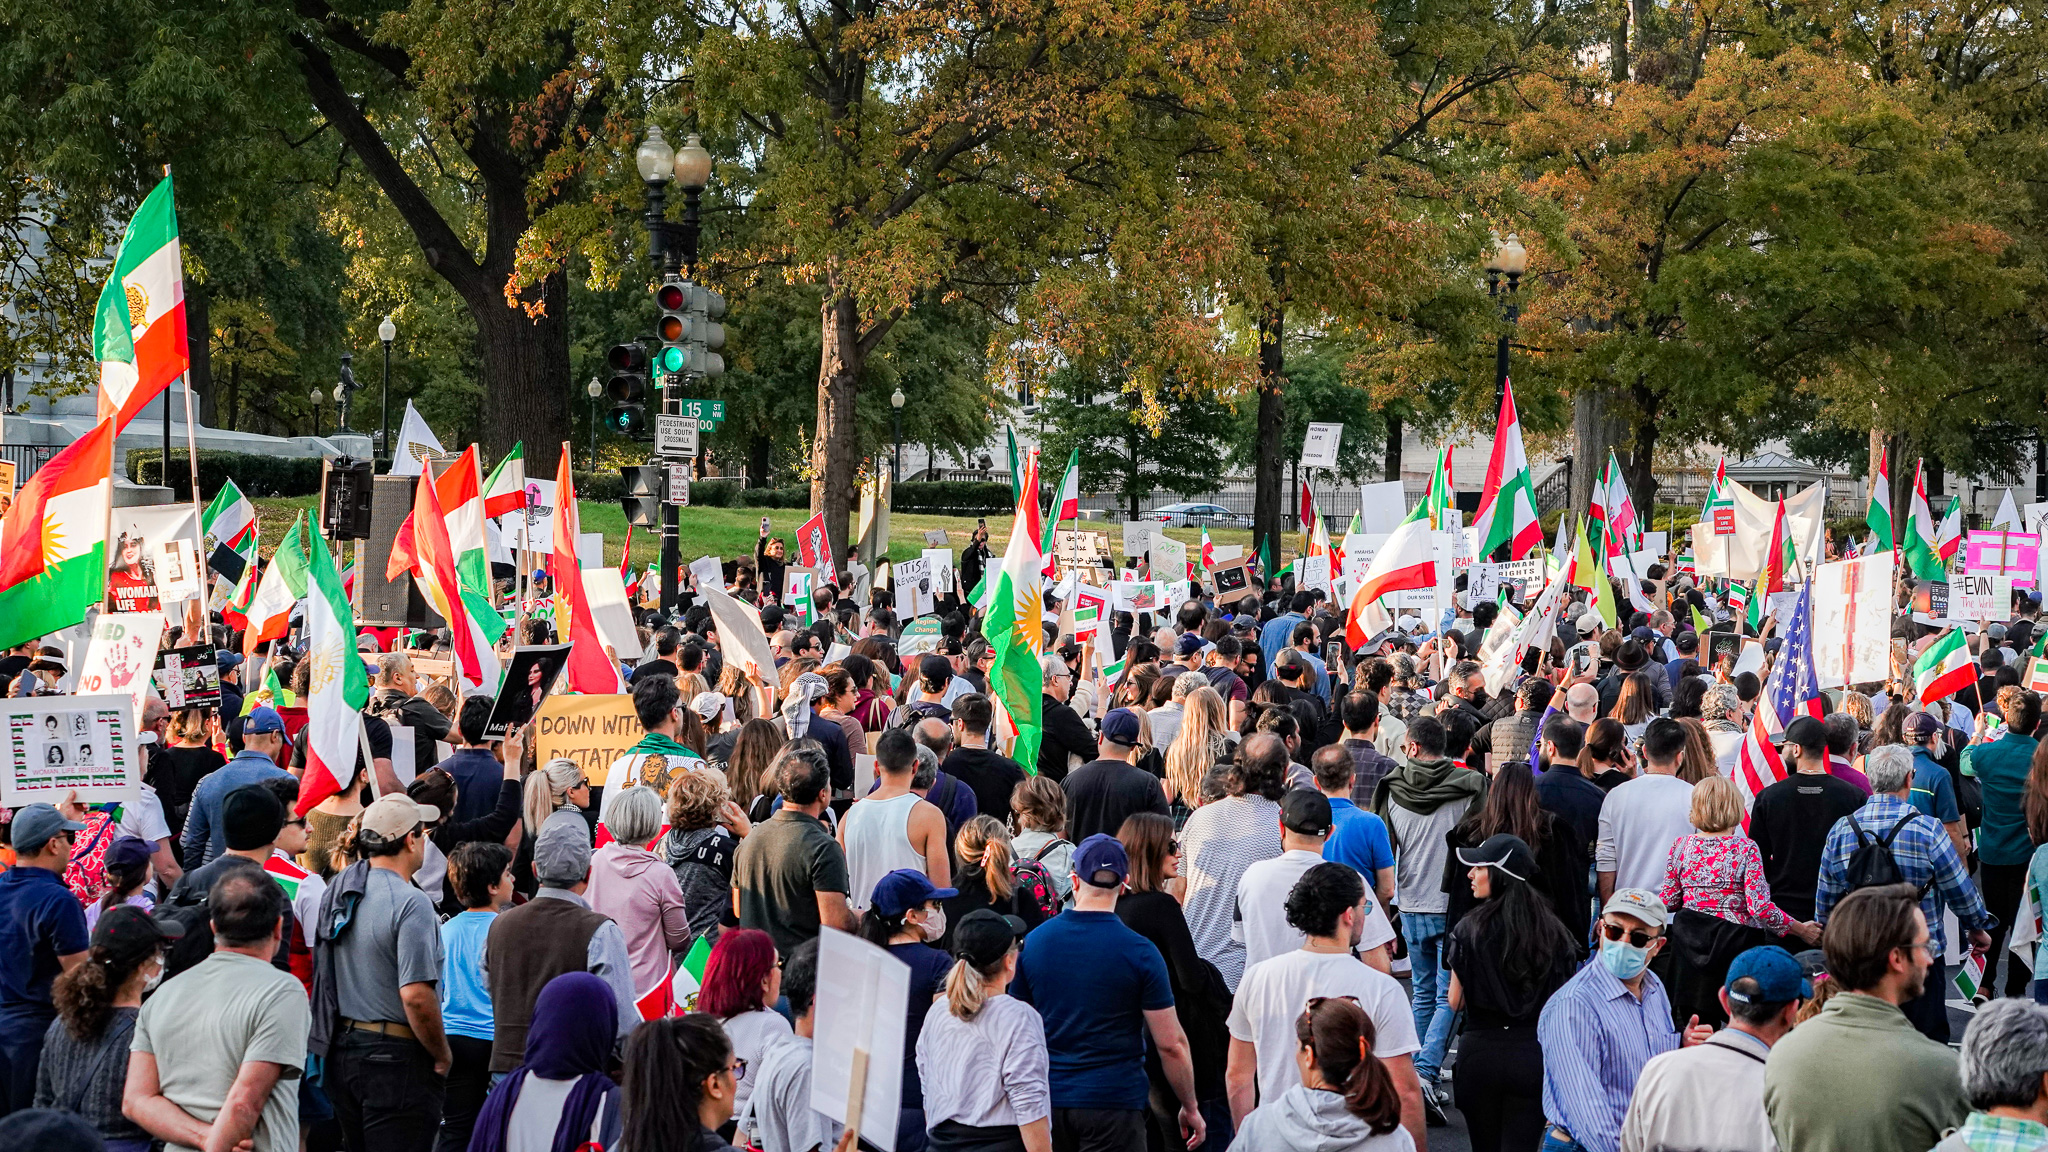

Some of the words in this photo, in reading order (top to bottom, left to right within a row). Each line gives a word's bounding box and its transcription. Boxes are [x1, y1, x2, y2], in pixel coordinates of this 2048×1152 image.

[687, 402, 701, 417] 15
[659, 419, 695, 429] PEDESTRIANS
[700, 420, 713, 430] 00
[660, 428, 673, 436] USE
[674, 428, 693, 436] SOUTH
[664, 436, 690, 444] CROSSWALK
[1452, 556, 1473, 567] IRAN
[1498, 561, 1535, 570] HUMAN
[1953, 576, 1993, 595] #EVIN
[116, 586, 157, 598] WOMAN
[116, 599, 136, 610] LIFE
[1960, 597, 1974, 608] The
[1979, 597, 1994, 608] World
[541, 715, 595, 736] DOWN
[603, 714, 644, 736] WITH
[551, 747, 625, 770] DICTATO
[78, 766, 109, 774] FREEDOM
[1730, 990, 1750, 1002] CANADA
